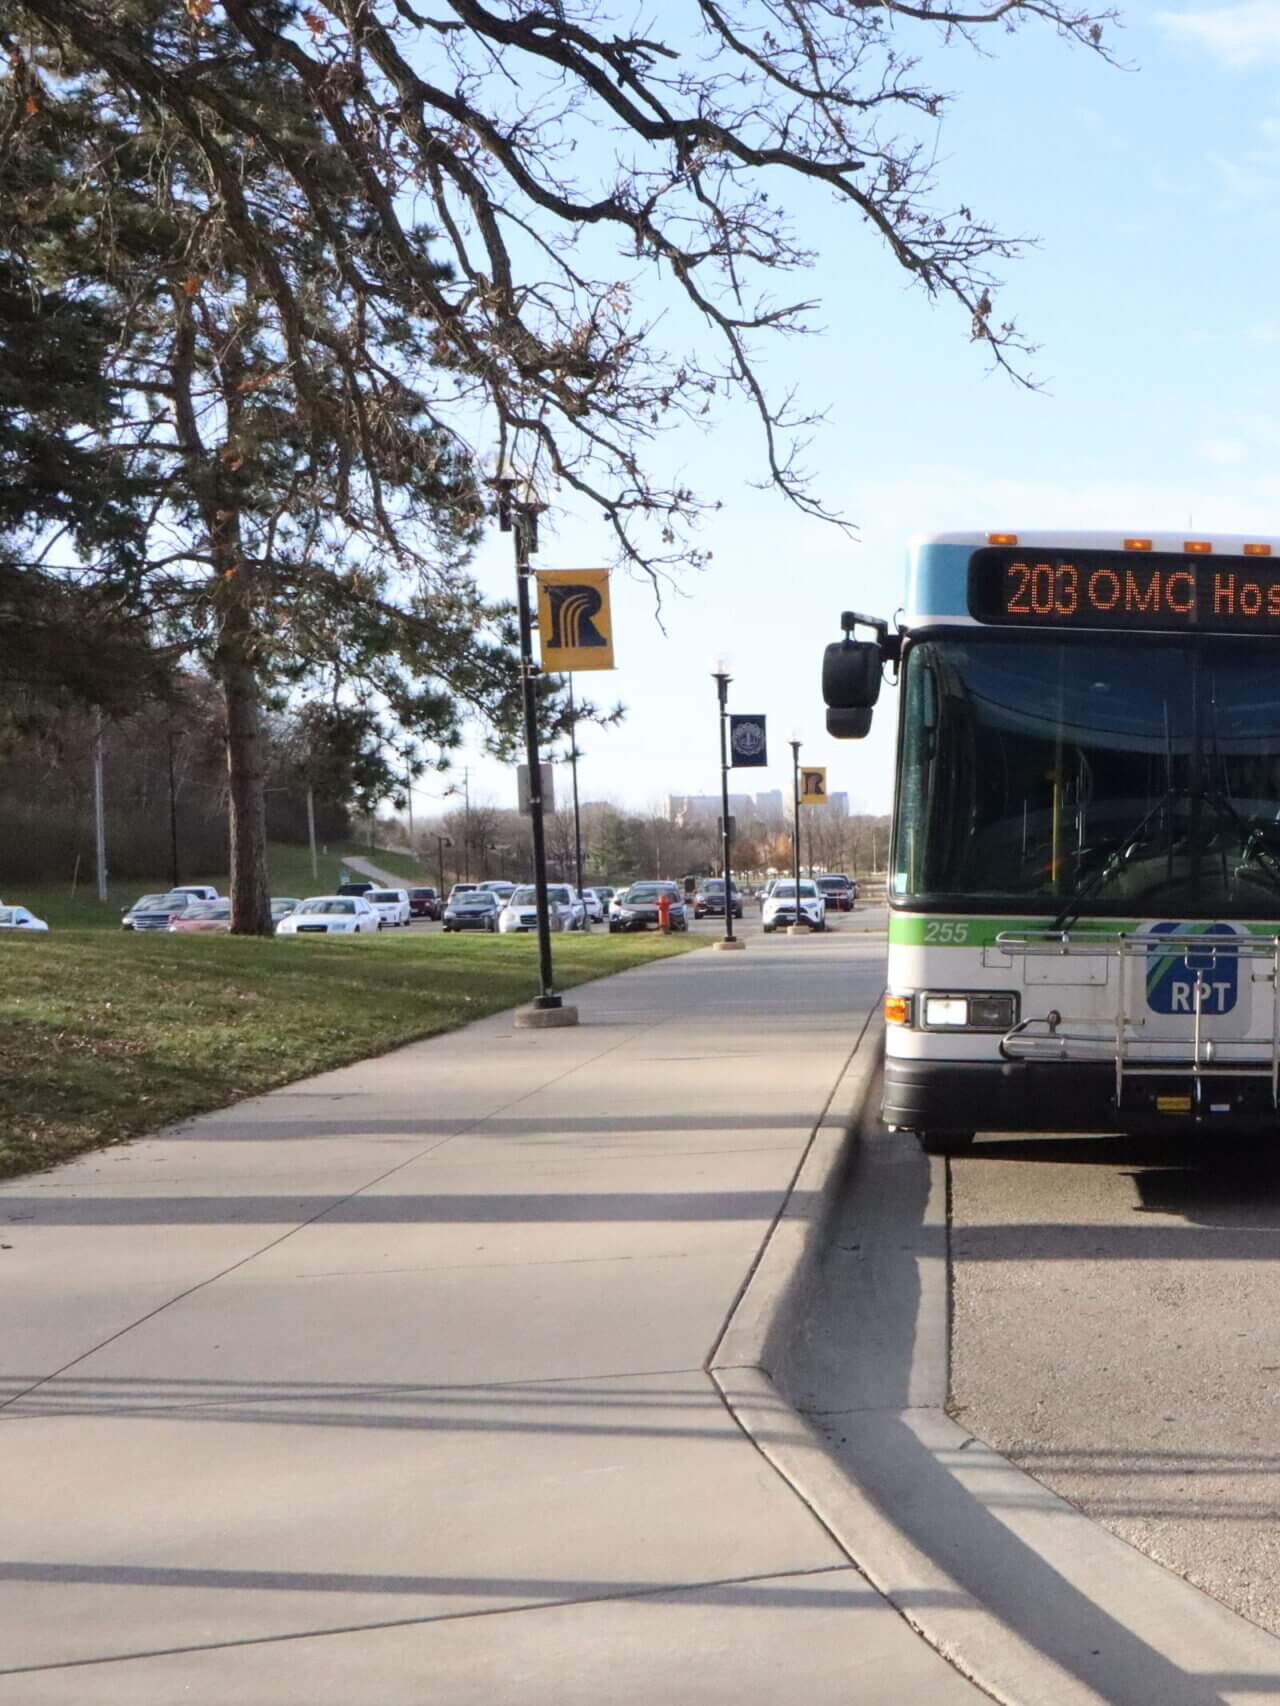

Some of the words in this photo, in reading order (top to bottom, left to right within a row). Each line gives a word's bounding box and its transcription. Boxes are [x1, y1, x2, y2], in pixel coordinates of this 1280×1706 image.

[1007, 563, 1078, 614] 203
[1087, 569, 1196, 612] OMC
[924, 921, 969, 943] 255
[1171, 981, 1232, 1012] RPT
